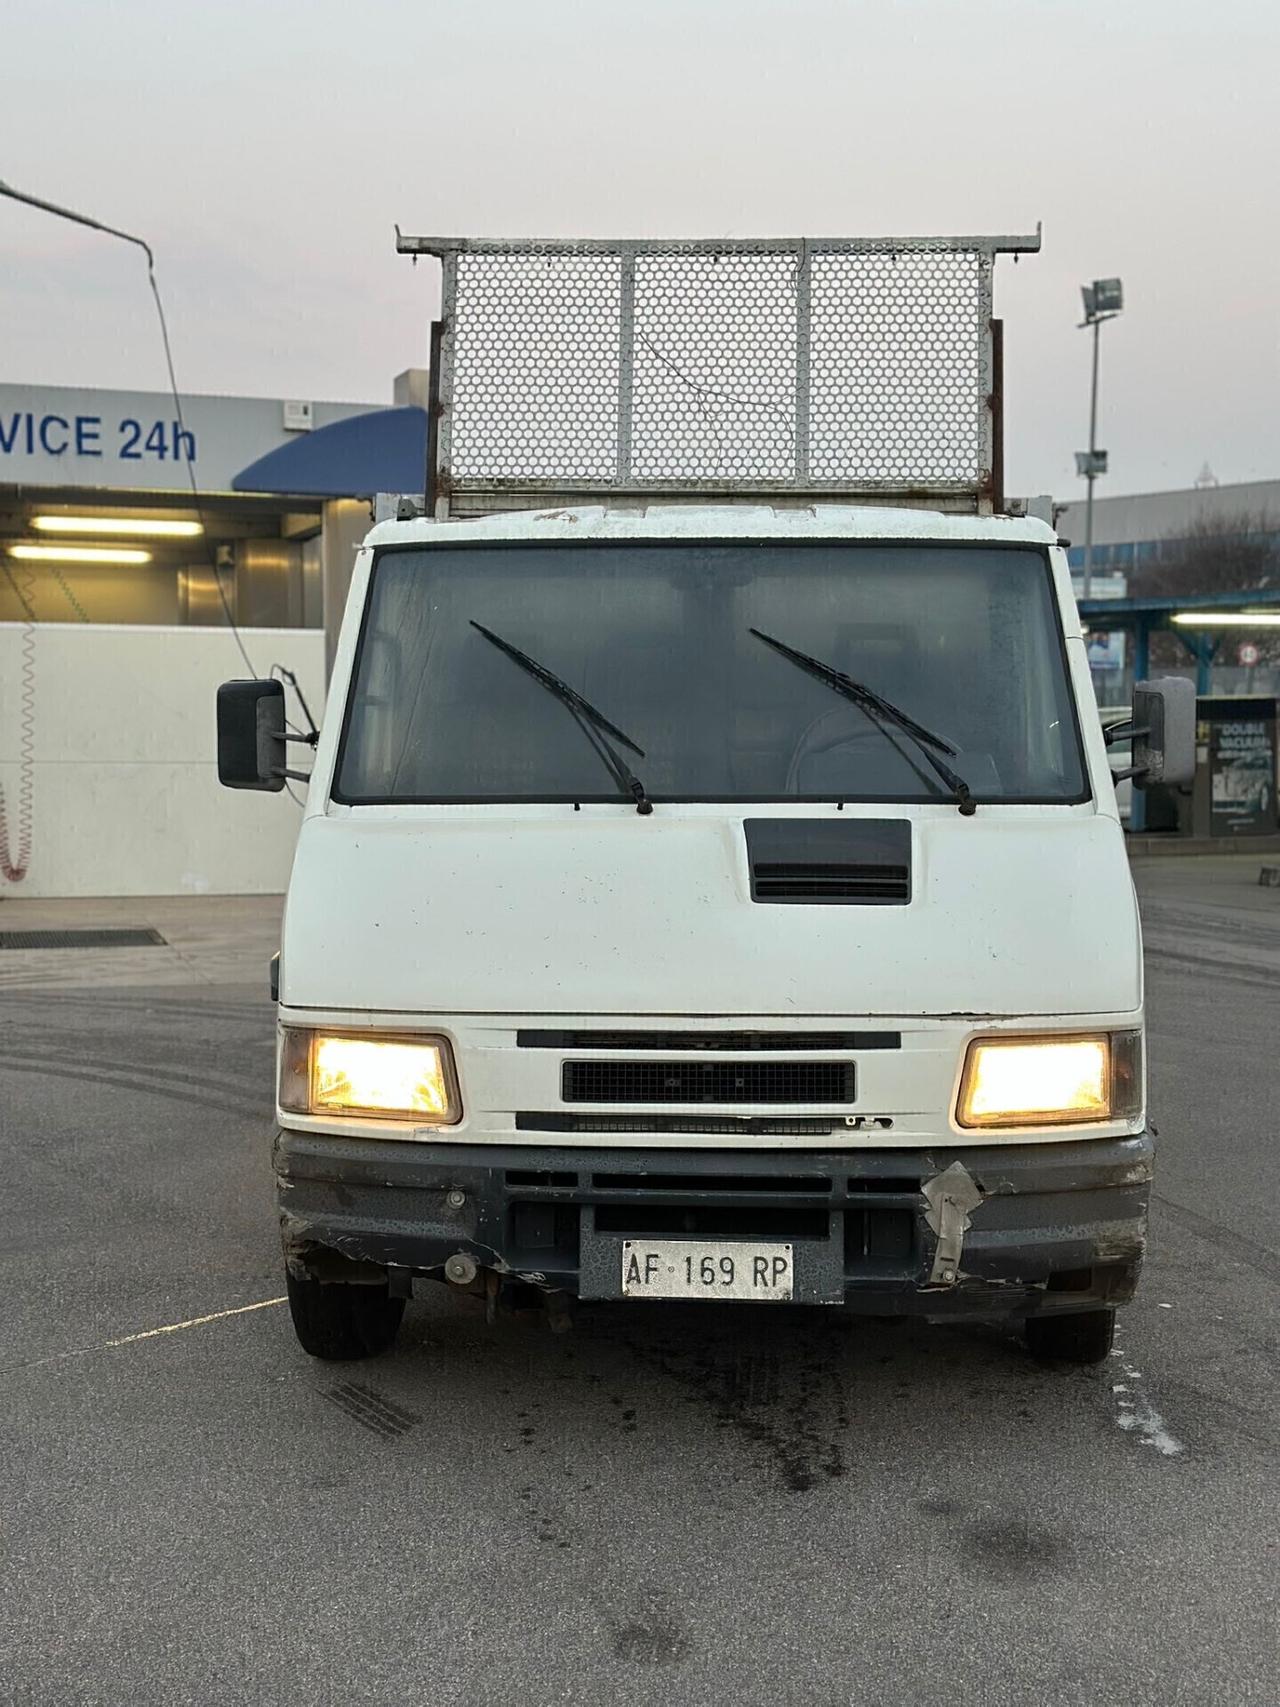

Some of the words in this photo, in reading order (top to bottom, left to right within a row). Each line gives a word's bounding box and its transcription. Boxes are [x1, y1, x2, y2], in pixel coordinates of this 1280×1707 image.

[0, 412, 102, 456] VICE
[119, 418, 196, 461] 24h
[626, 1253, 660, 1284] AF
[685, 1256, 735, 1286] 169
[753, 1256, 788, 1287] RP
